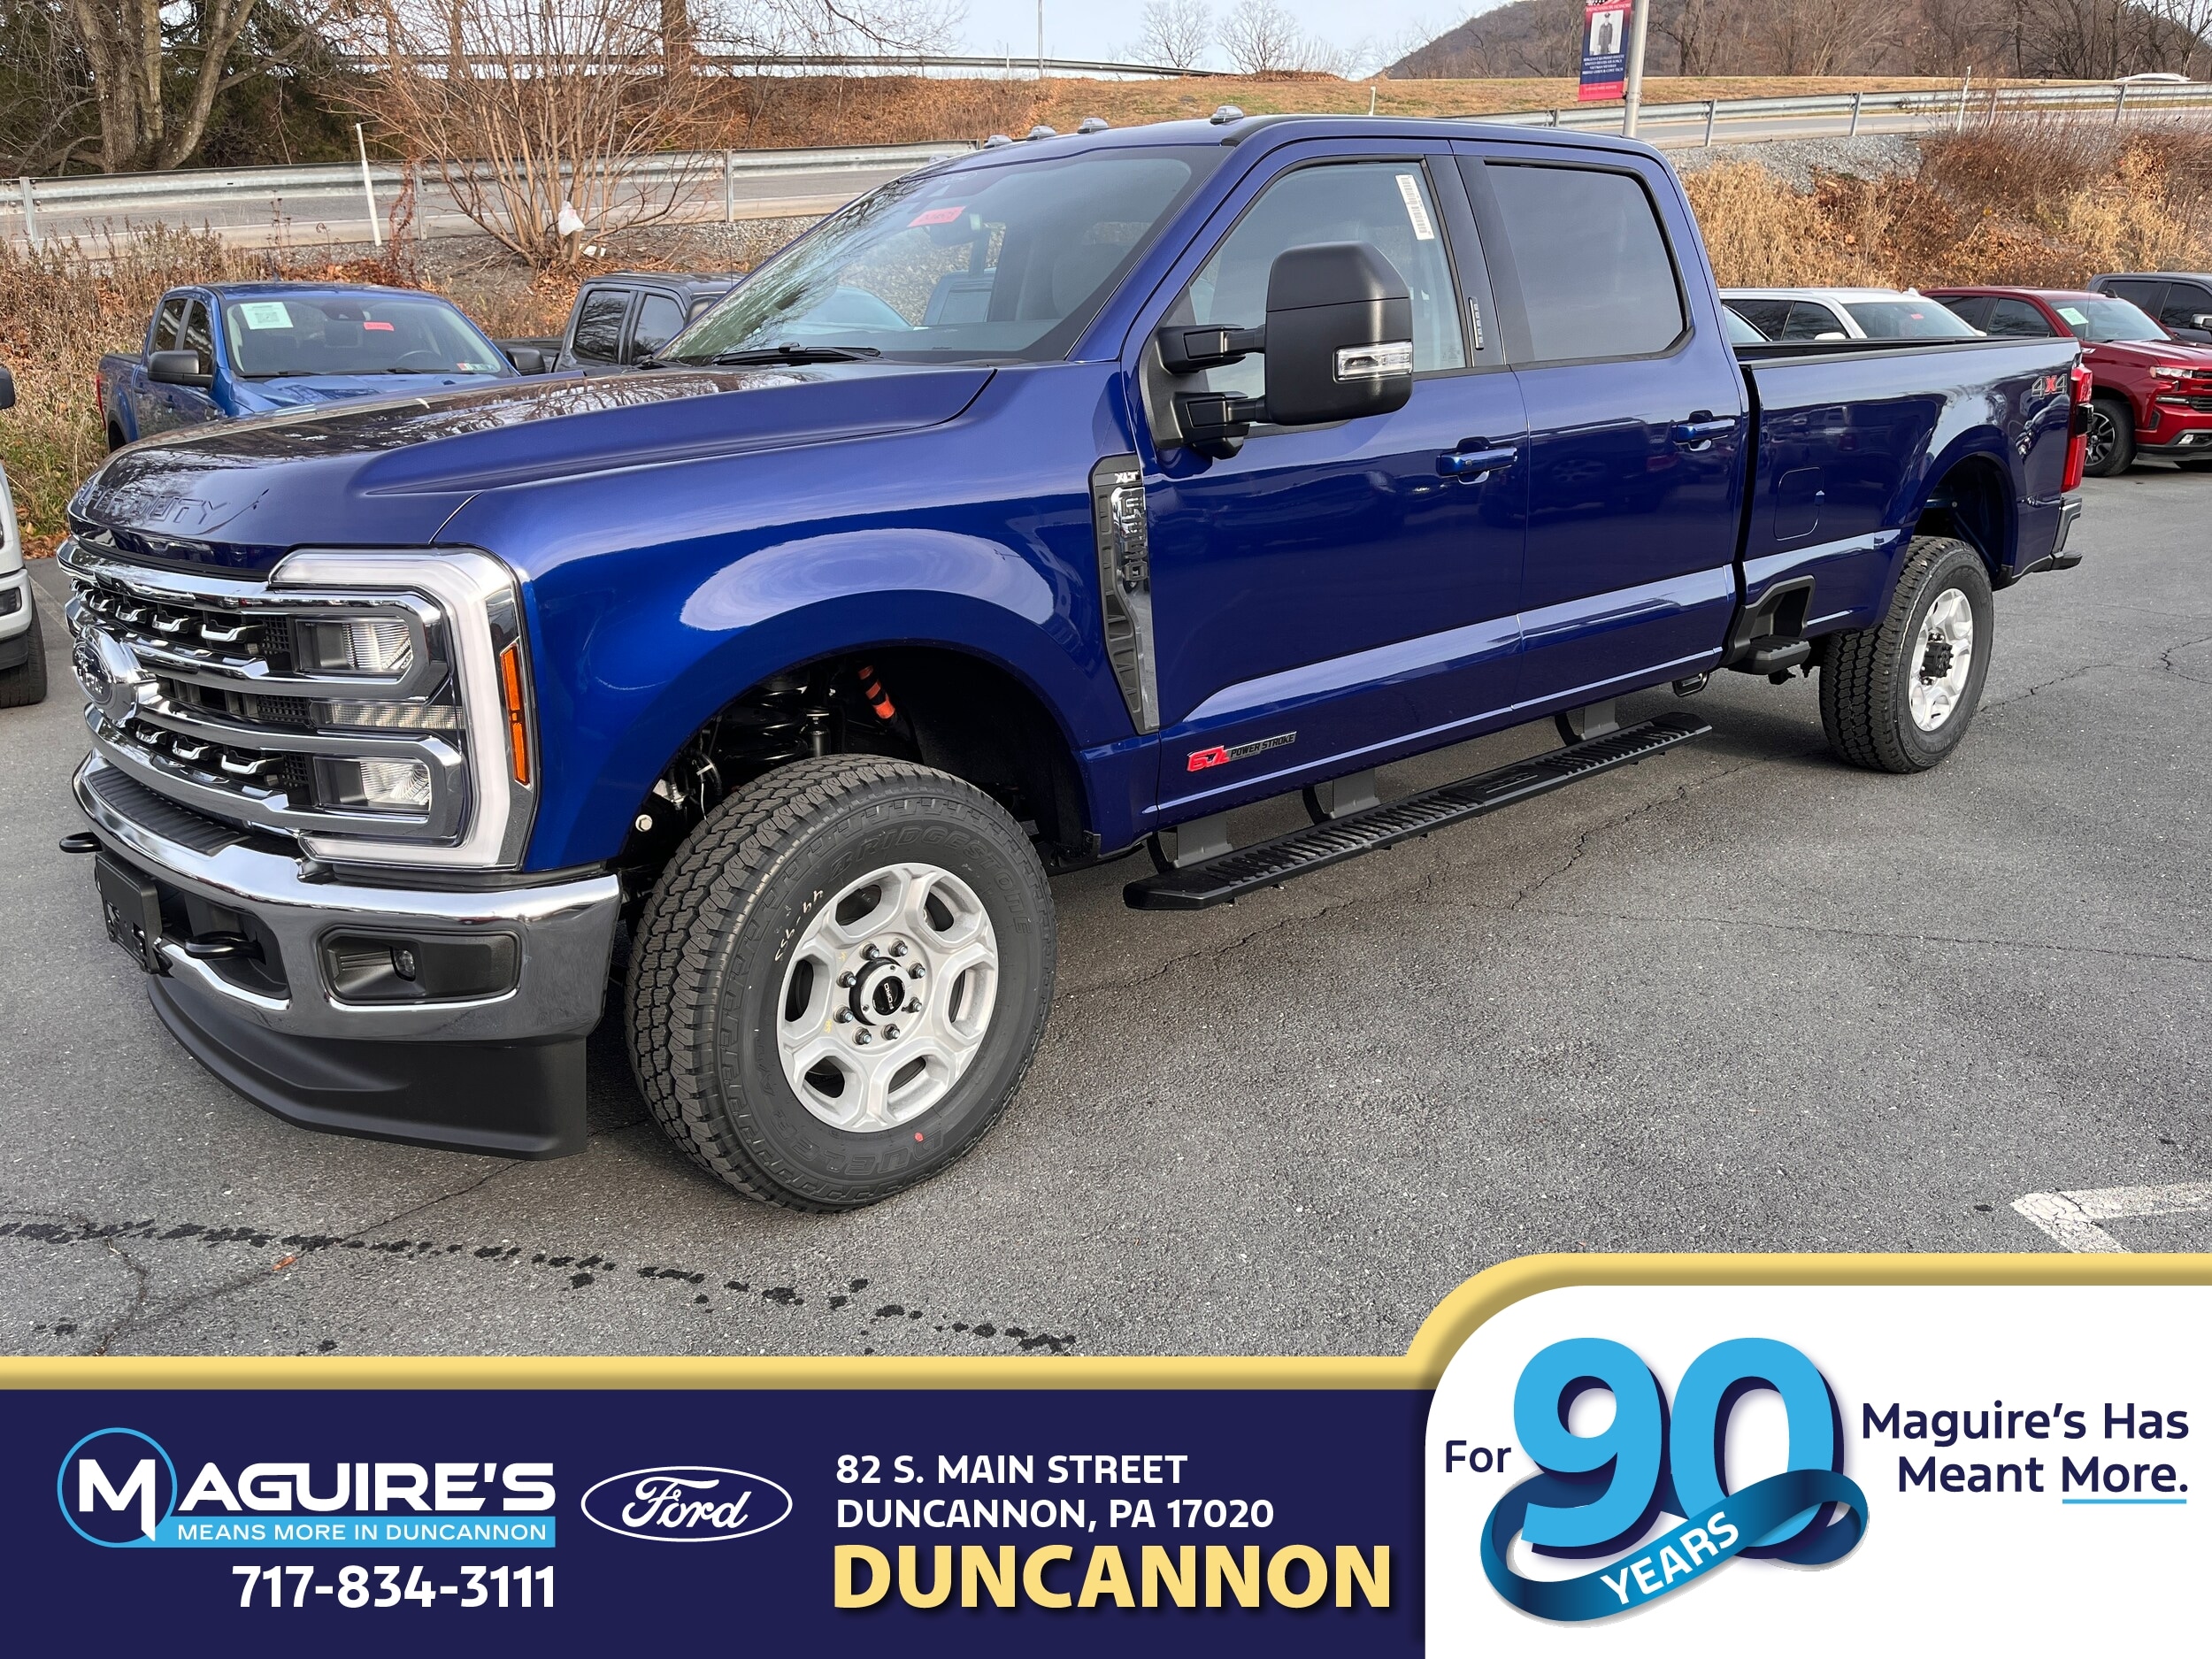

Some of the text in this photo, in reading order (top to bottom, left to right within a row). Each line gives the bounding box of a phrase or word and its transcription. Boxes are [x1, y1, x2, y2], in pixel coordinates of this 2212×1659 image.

[1115, 471, 1139, 484] XLT
[1231, 742, 1261, 757] POWER
[1261, 733, 1294, 750] STROKE
[828, 826, 1033, 935] BRIDGESTONE
[770, 1109, 944, 1176] DUELER
